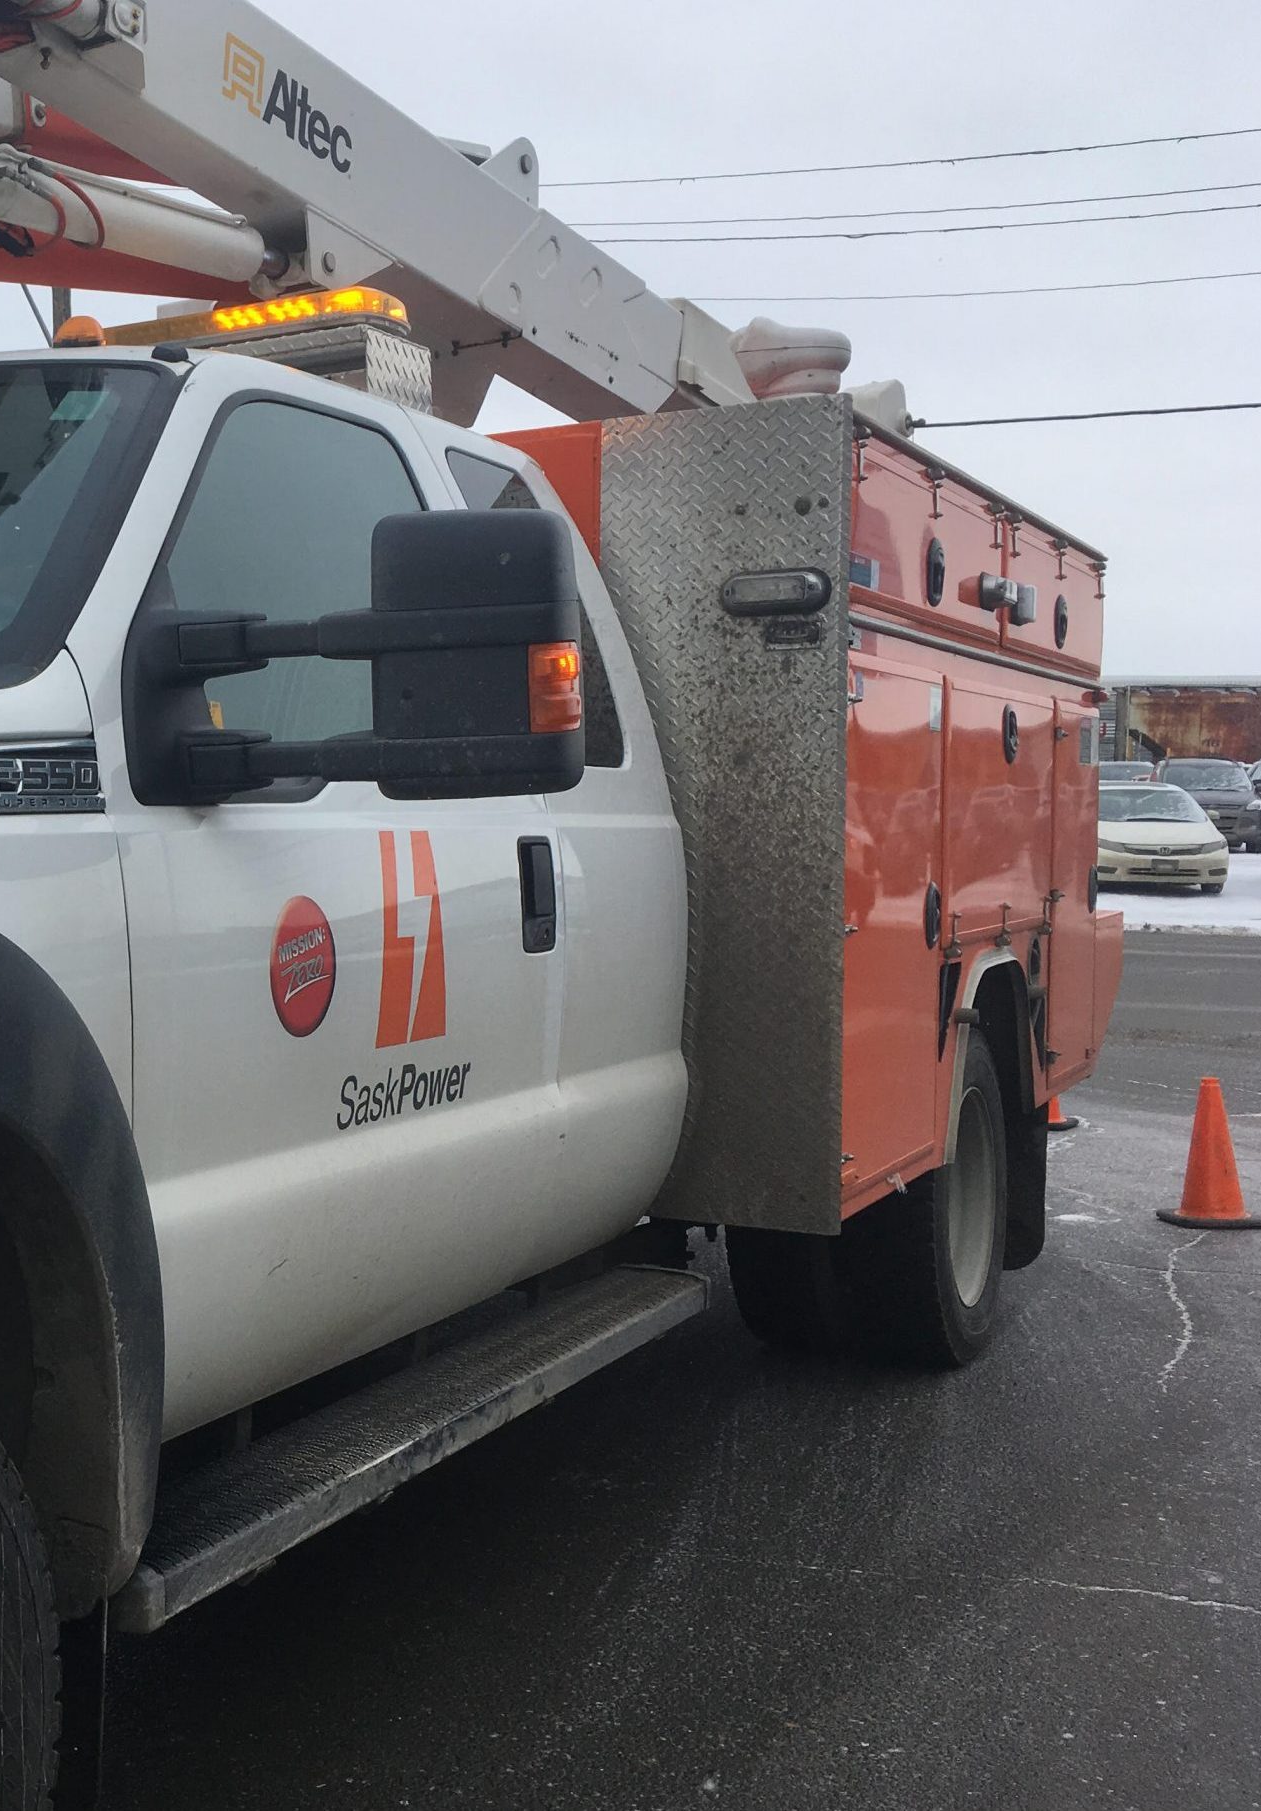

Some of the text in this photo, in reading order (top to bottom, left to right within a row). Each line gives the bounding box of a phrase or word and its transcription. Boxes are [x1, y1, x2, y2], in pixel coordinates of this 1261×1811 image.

[262, 68, 352, 174] Altec
[59, 797, 102, 808] DUTY
[278, 926, 326, 963] MISSION:
[336, 1062, 472, 1131] SaskPower
